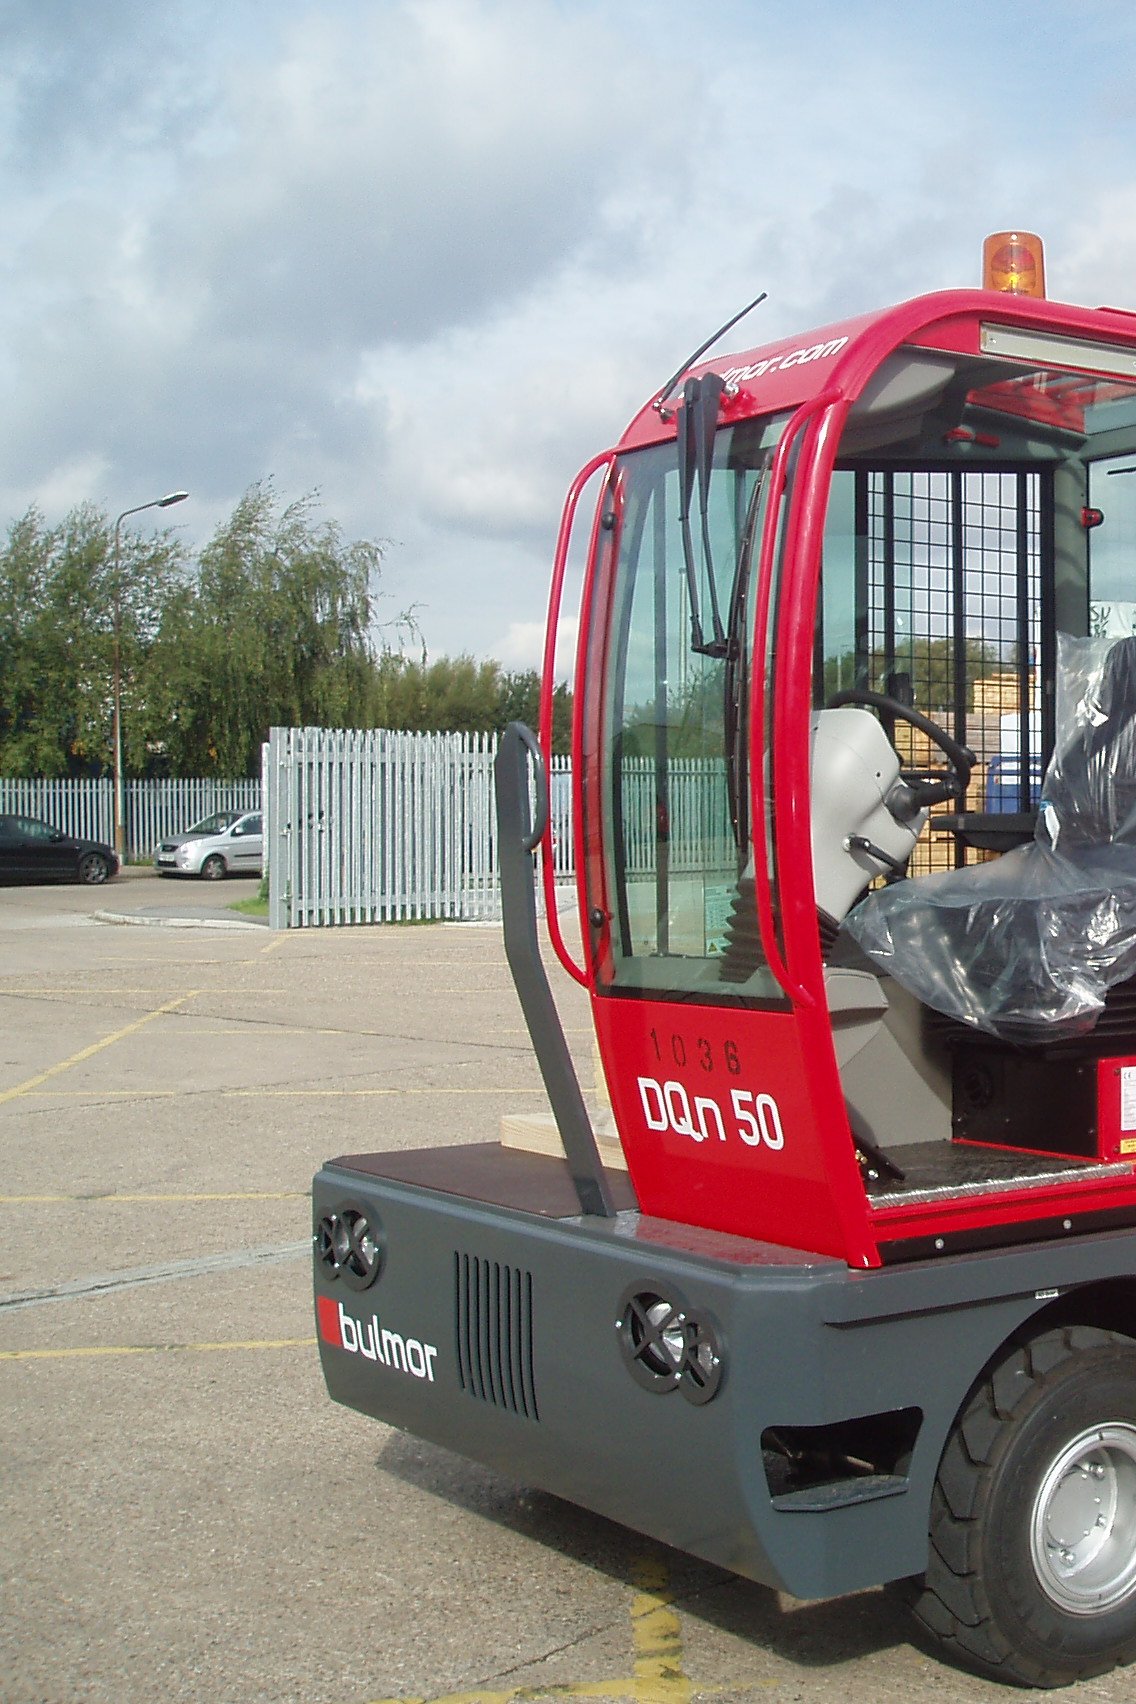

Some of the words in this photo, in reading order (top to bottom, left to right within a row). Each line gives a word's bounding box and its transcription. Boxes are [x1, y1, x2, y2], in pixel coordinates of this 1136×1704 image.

[650, 1027, 741, 1075] 1036
[637, 1076, 727, 1143] DQn
[730, 1088, 785, 1151] 50
[338, 1301, 438, 1383] bulmor
